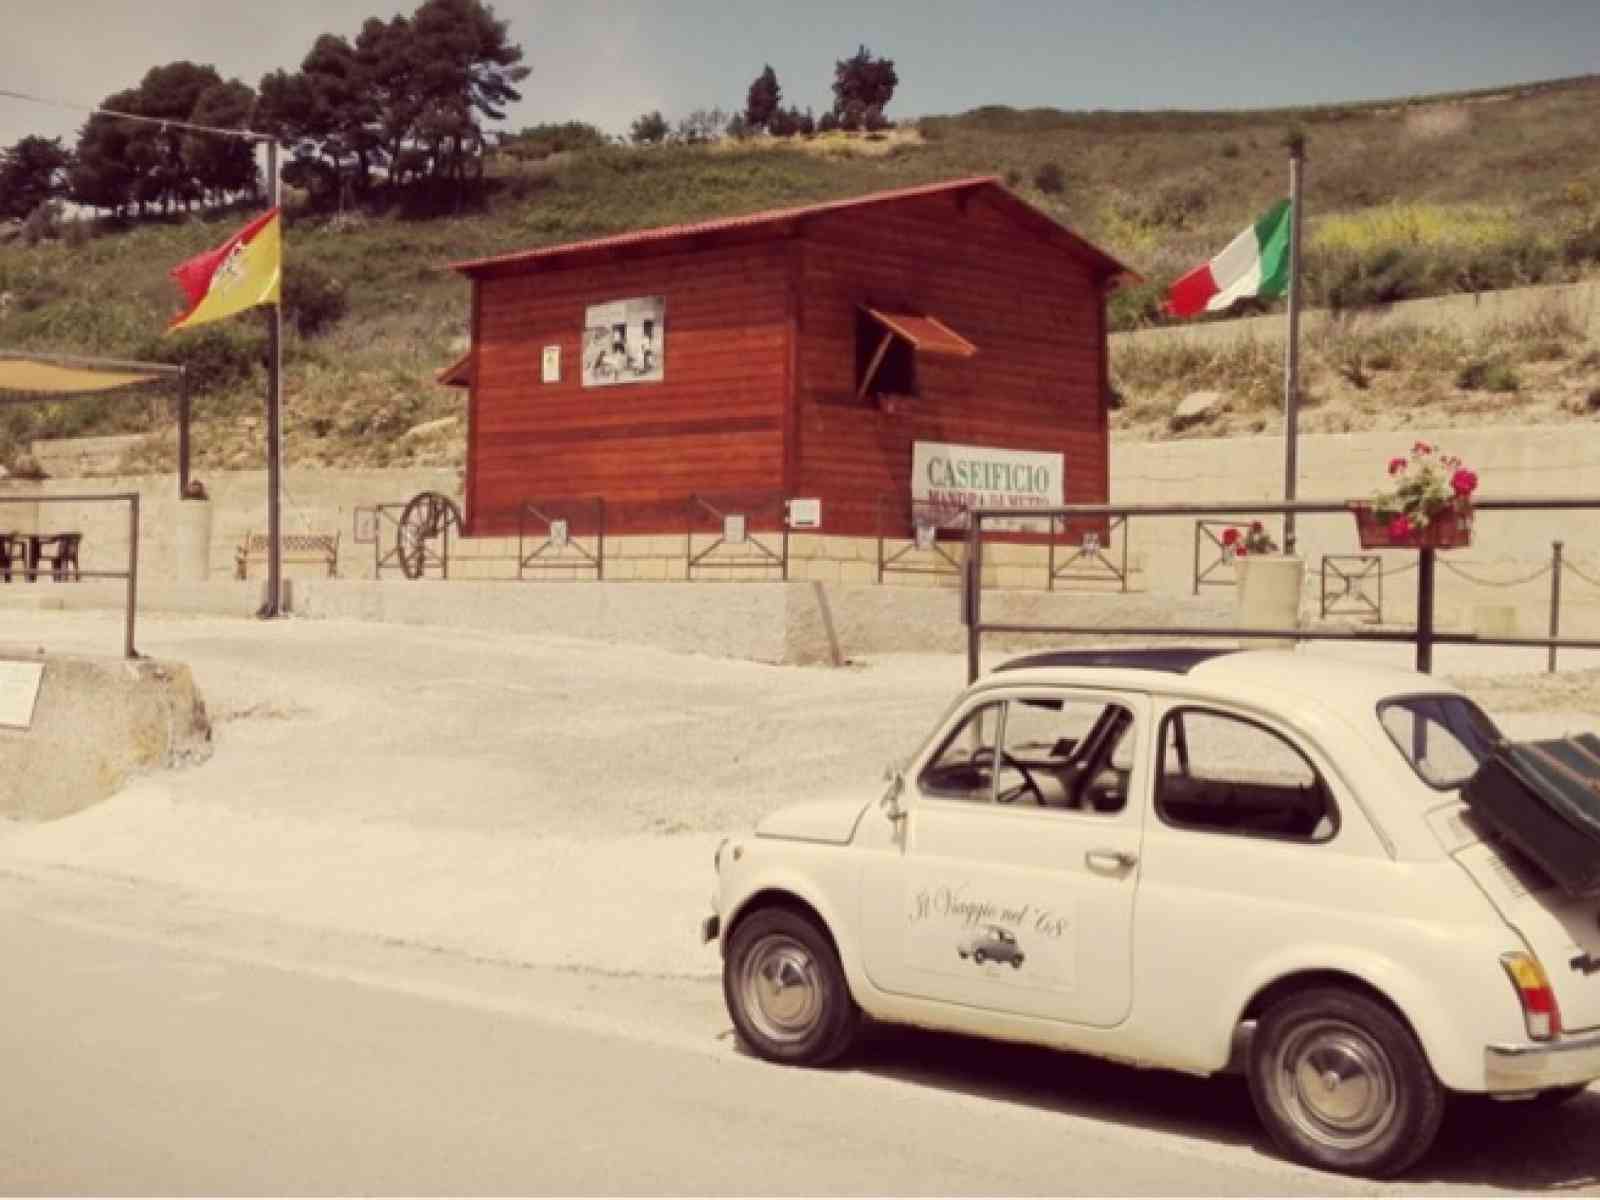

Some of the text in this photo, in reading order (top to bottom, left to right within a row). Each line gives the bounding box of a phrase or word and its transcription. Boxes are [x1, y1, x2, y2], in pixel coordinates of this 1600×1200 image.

[927, 456, 1050, 493] CASEIFICIO
[934, 880, 995, 927] Viaggio
[1000, 904, 1029, 925] nel
